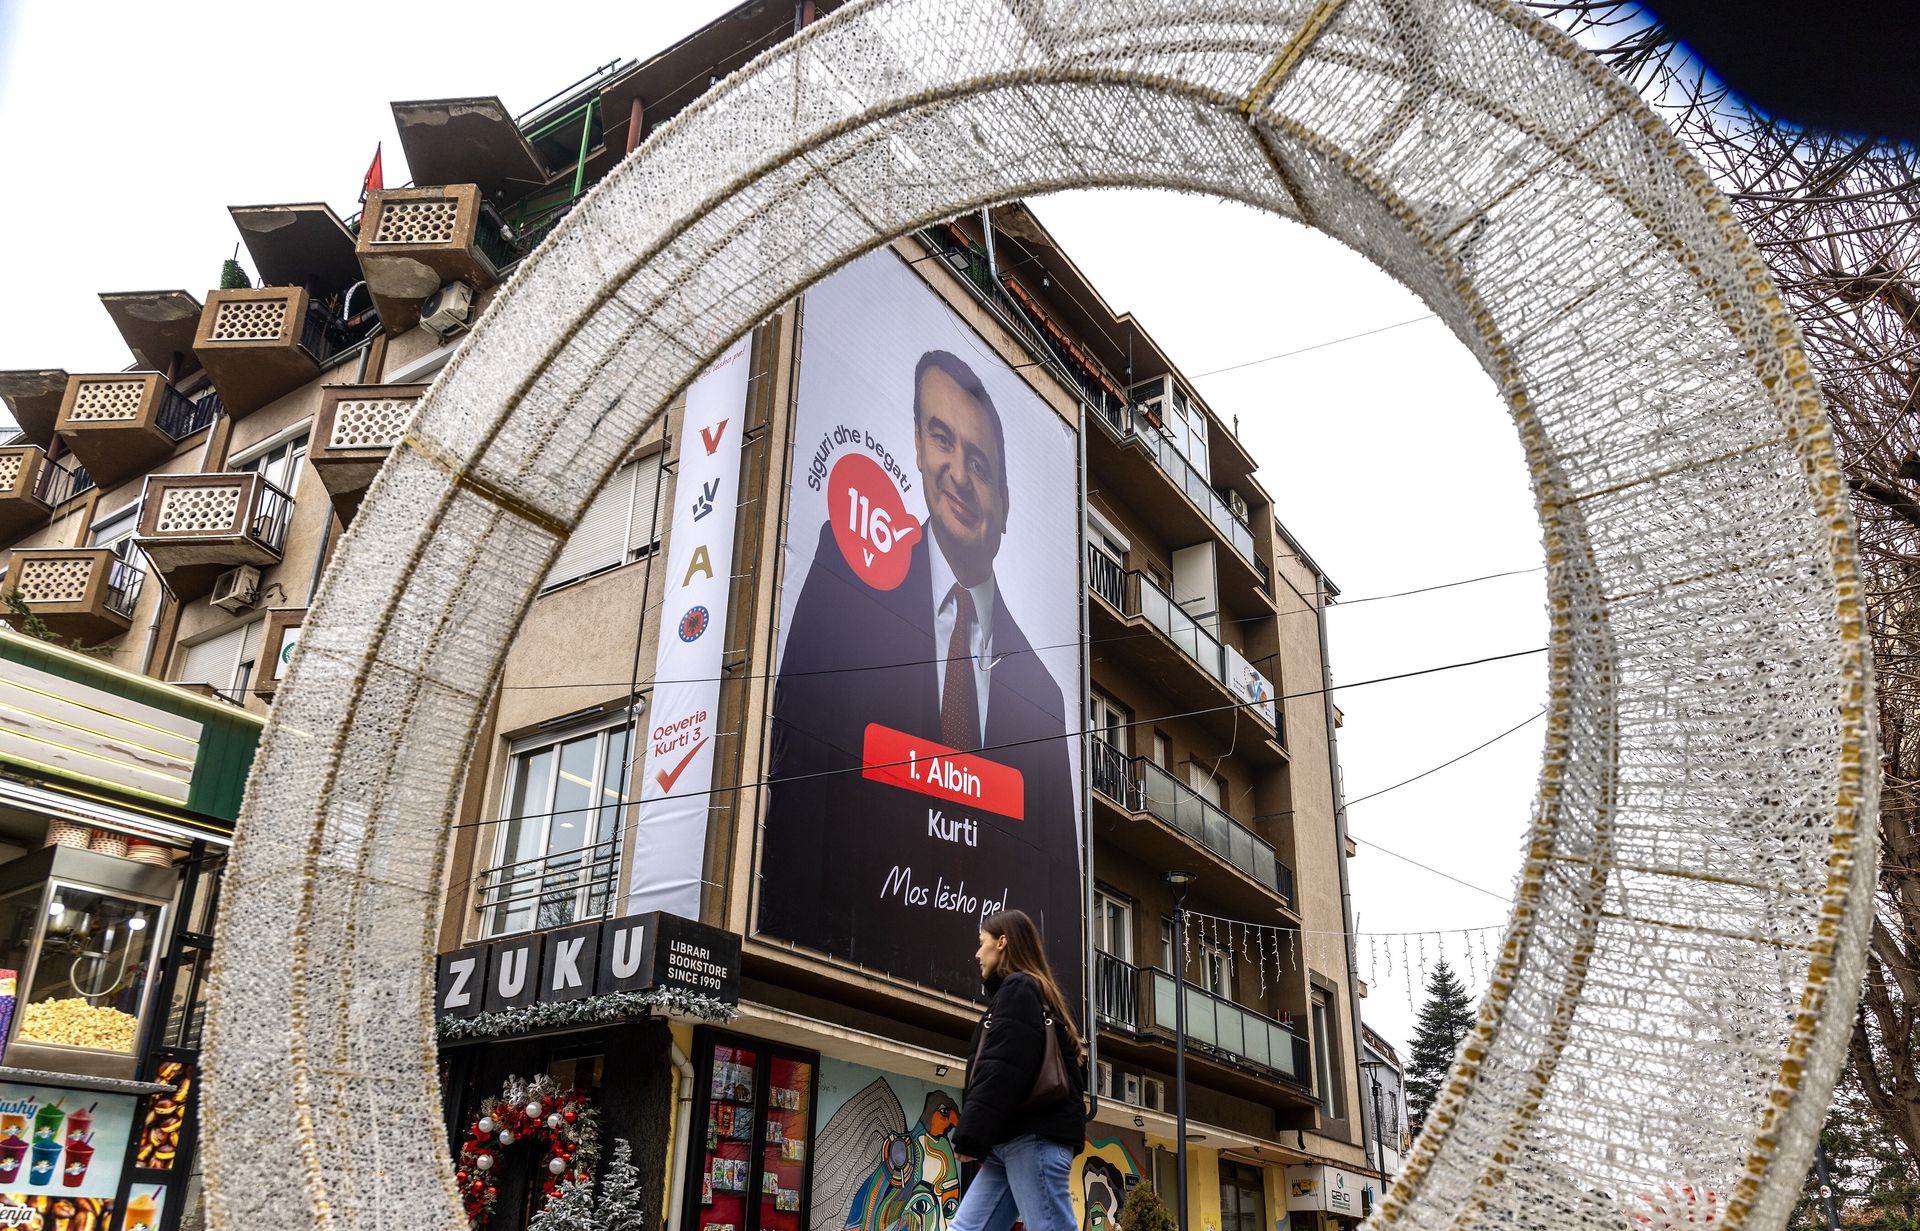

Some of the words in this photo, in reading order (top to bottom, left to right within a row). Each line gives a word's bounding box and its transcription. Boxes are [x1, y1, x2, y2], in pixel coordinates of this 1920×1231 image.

[833, 424, 861, 444] dhe
[865, 430, 912, 493] begati
[848, 487, 893, 553] 116
[653, 710, 707, 741] Qeveria
[654, 732, 689, 758] Kurti
[692, 727, 702, 742] 3
[909, 749, 921, 780] 1.
[926, 757, 981, 798] Albin
[927, 808, 978, 847] Kurti
[880, 865, 929, 906] Mos
[934, 876, 977, 914] lësho
[444, 925, 645, 1009] ZUKU
[669, 953, 728, 979] BOOKSTORE
[670, 939, 710, 960] LIBRARI
[667, 966, 698, 985] SINCE
[700, 975, 721, 990] 1990
[0, 1098, 38, 1119] ushy
